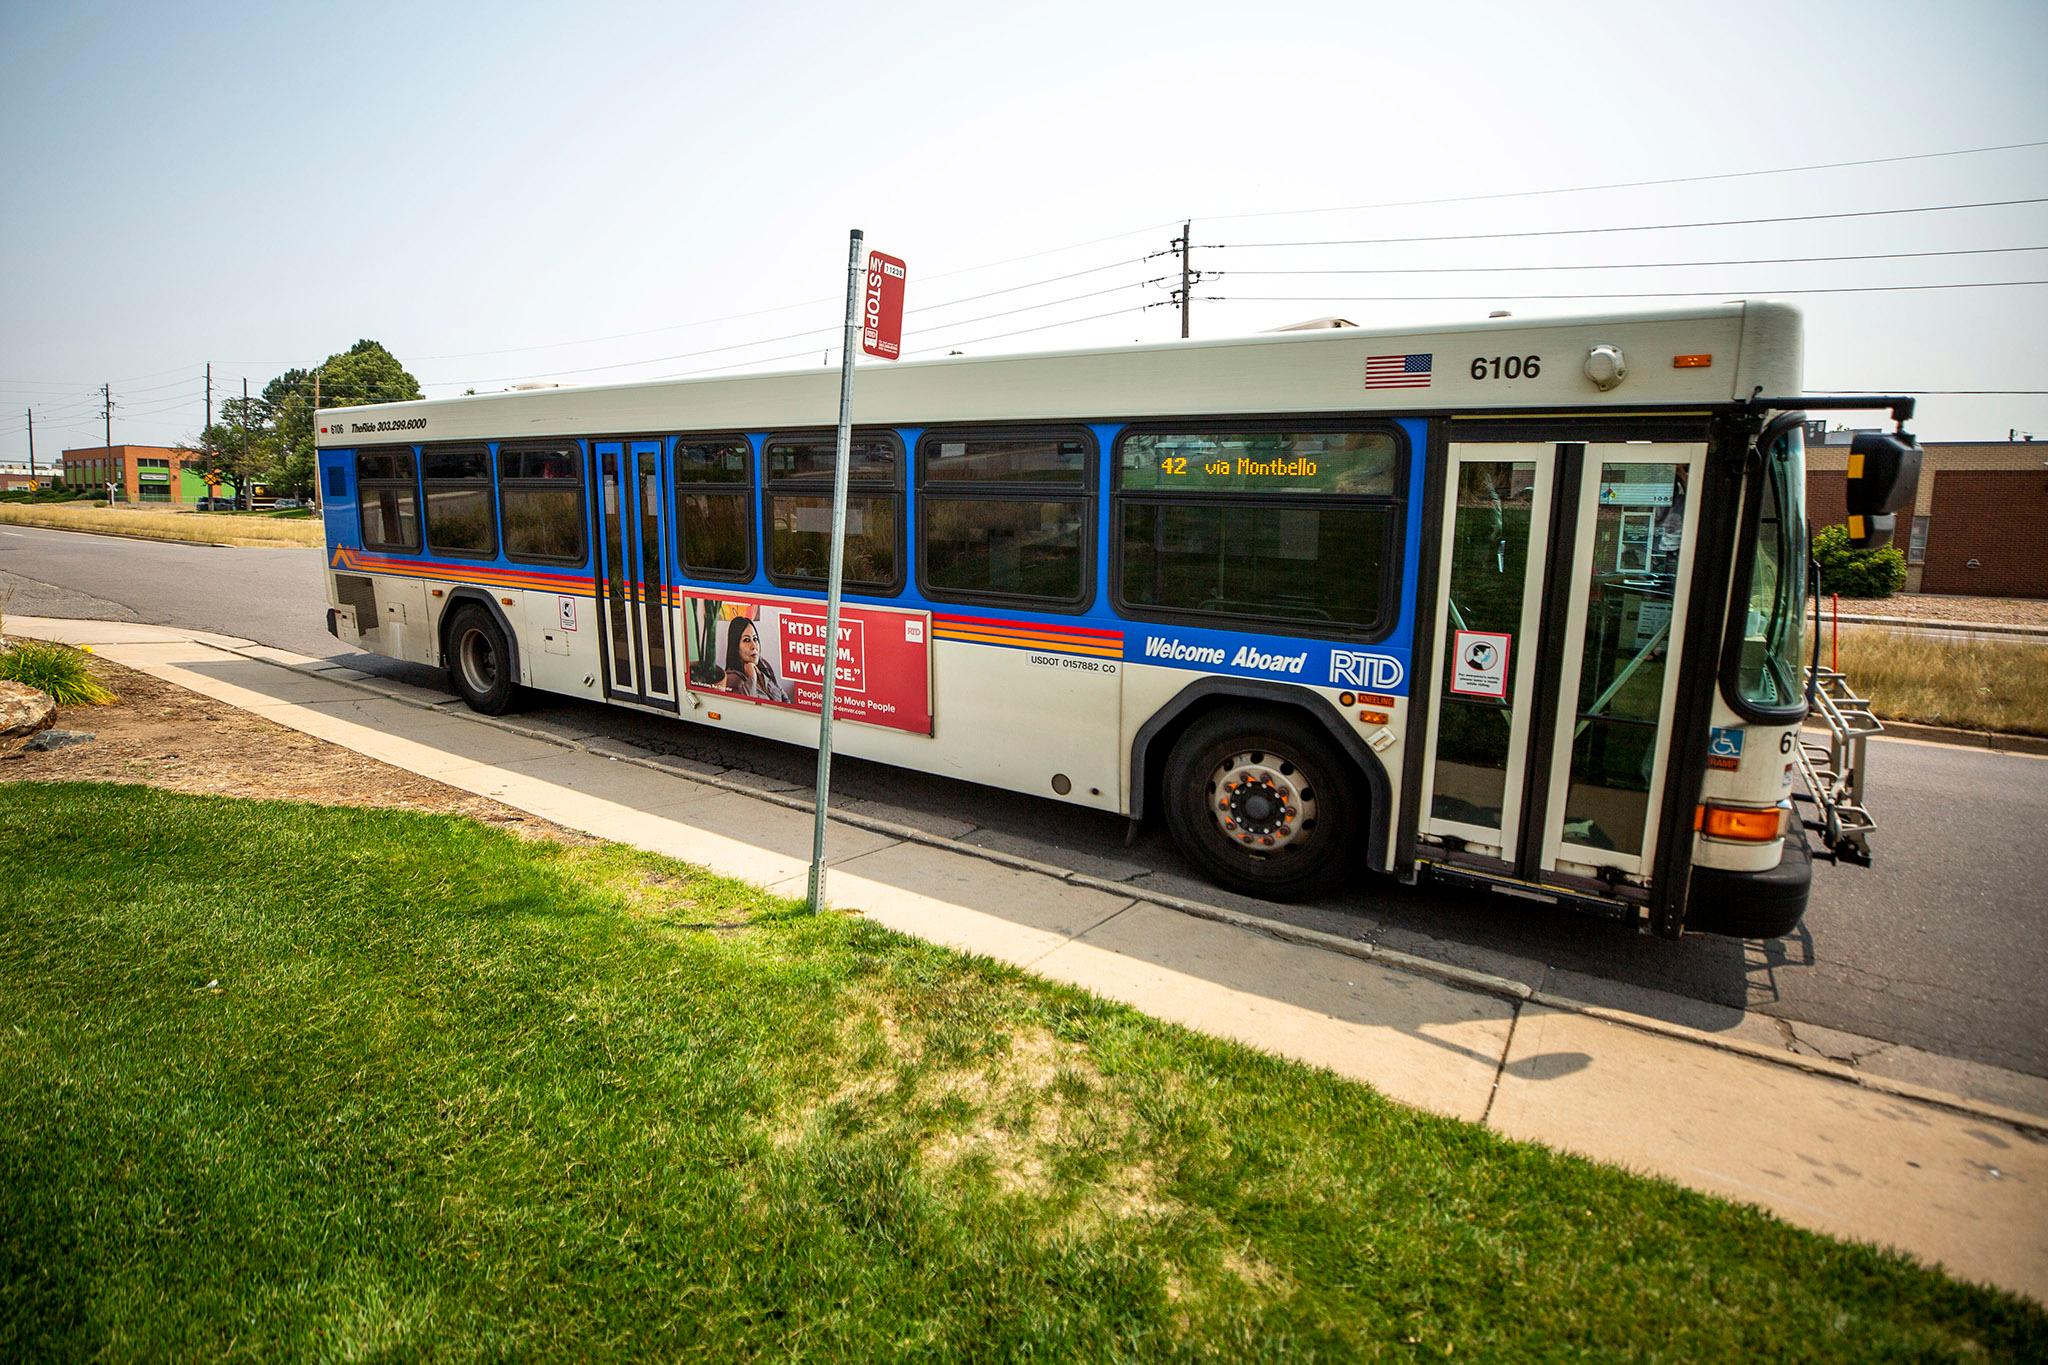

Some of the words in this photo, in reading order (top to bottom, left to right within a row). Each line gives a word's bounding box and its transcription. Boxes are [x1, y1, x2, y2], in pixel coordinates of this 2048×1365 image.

[869, 256, 884, 273] MY
[866, 272, 882, 329] STOP
[1470, 355, 1541, 380] 6106
[330, 424, 344, 434] 6106
[351, 422, 376, 433] TheRide
[377, 418, 427, 432] 303.299.6000
[1161, 457, 1187, 475] 42
[1205, 459, 1230, 475] via
[1237, 457, 1317, 476] Montbello
[789, 641, 855, 664] FREEDM,
[1144, 636, 1225, 665] Welcome
[1231, 646, 1308, 674] Aboard
[790, 660, 809, 674] MY
[812, 664, 860, 682] VCE.”
[1031, 656, 1059, 667] USDOT
[1062, 660, 1099, 672] 0157882
[1102, 664, 1116, 674] CO
[1329, 649, 1404, 689] RTD
[797, 688, 823, 700] People
[844, 695, 866, 708] Move
[867, 700, 896, 713] People
